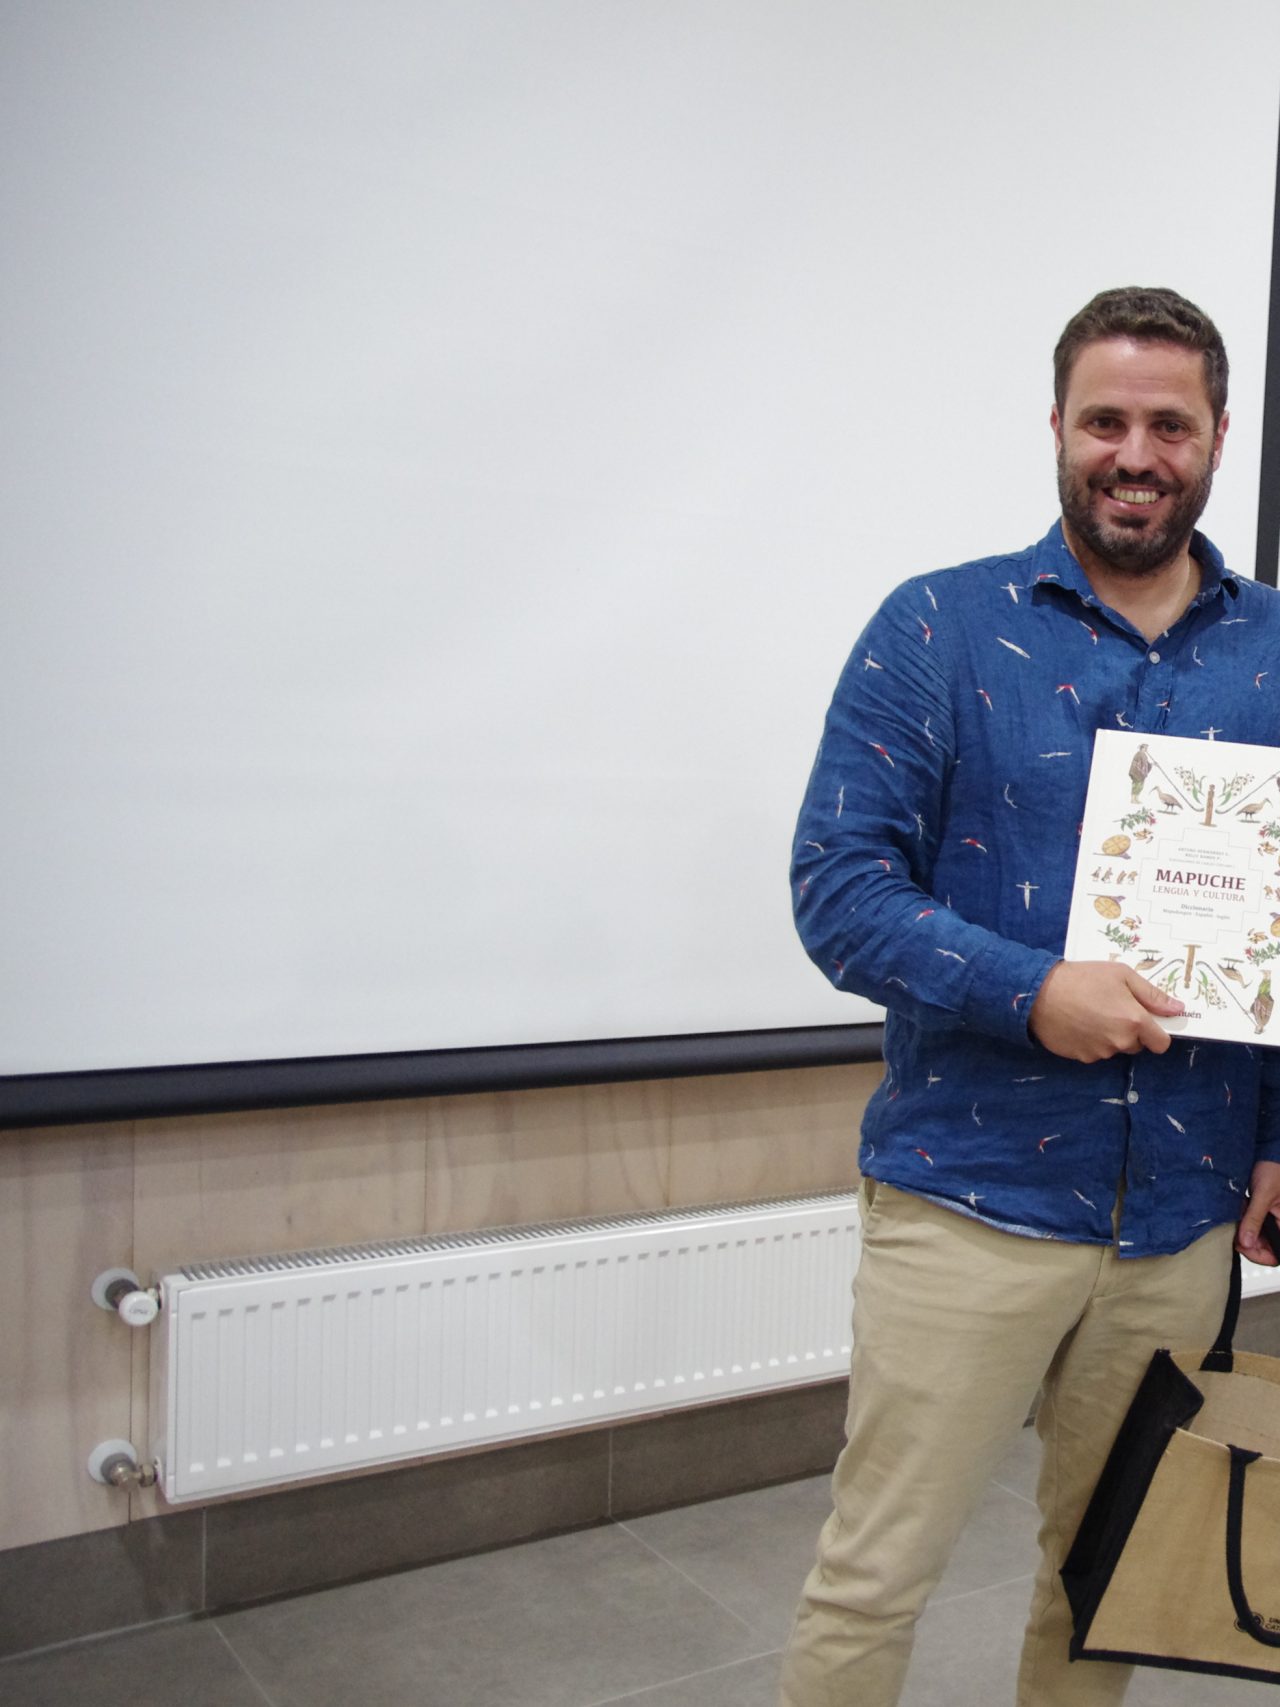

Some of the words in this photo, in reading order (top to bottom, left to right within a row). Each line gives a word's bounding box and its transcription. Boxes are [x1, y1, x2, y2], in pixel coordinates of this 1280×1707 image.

[1155, 869, 1246, 890] MAPUCHE
[1152, 885, 1190, 897] LENGUA
[1191, 889, 1200, 897] Y
[1203, 890, 1246, 903] CULTURA
